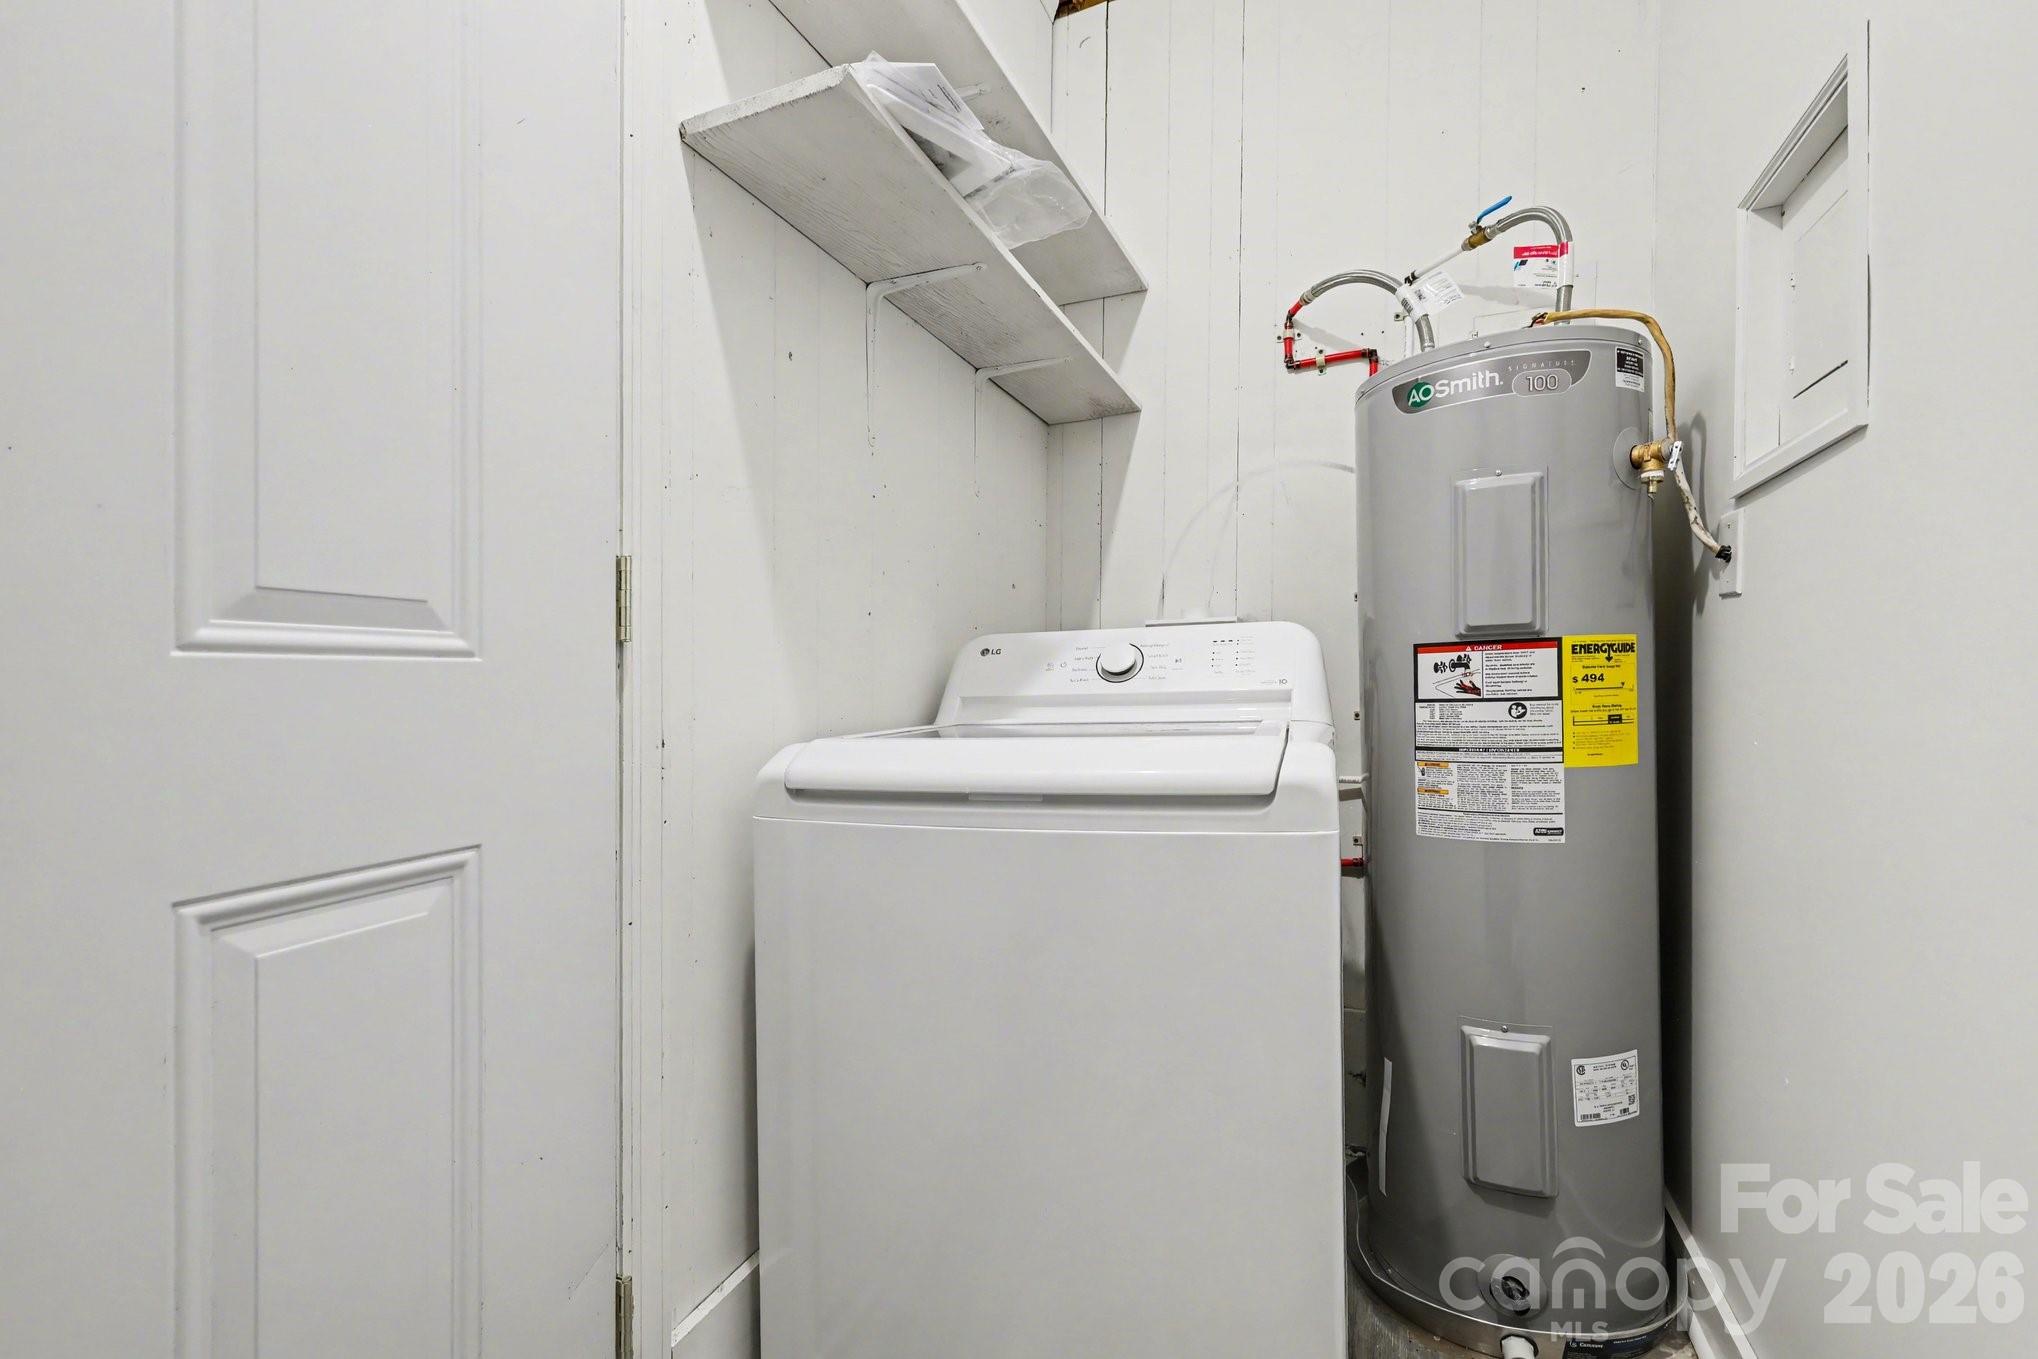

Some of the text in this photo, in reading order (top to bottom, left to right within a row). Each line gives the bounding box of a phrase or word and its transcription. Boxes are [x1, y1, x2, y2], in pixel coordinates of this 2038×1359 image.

[1526, 374, 1558, 391] 100
[1571, 642, 1635, 655] ENERGYGUIDE
[1581, 673, 1605, 682] 494
